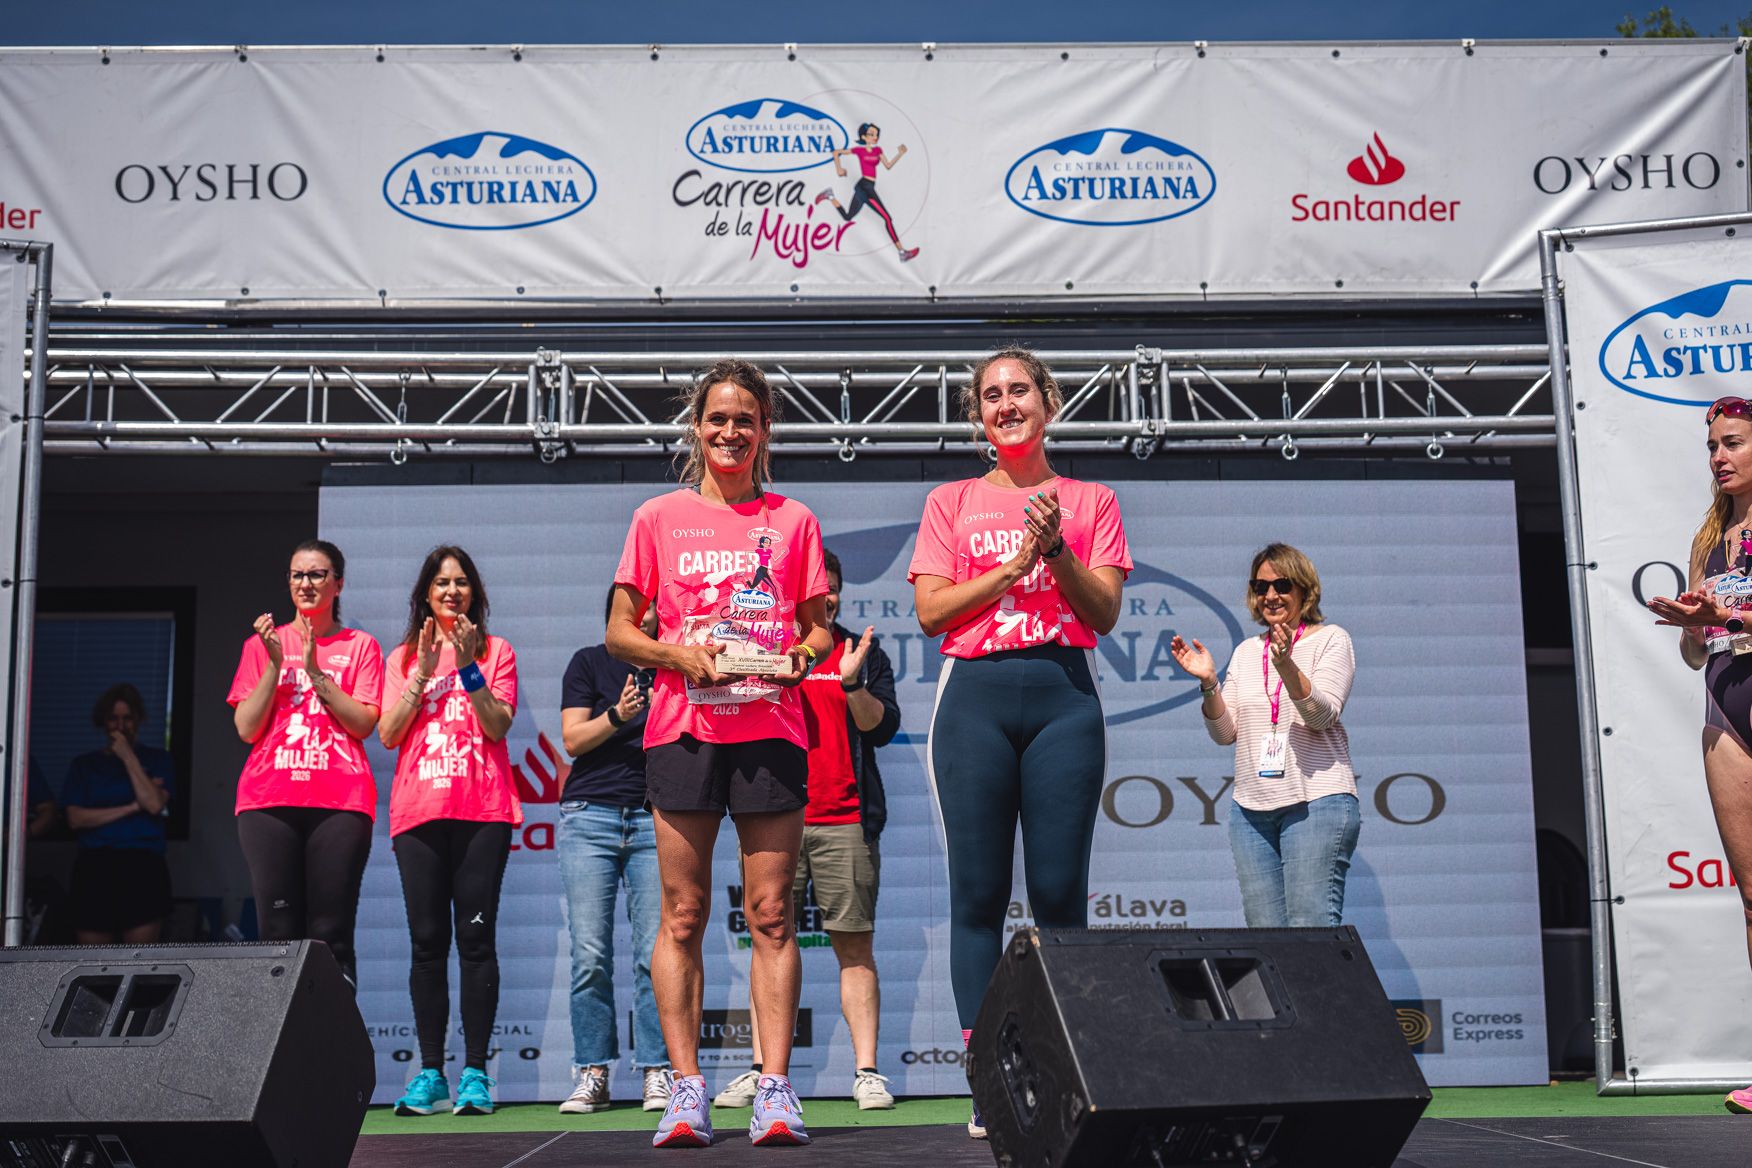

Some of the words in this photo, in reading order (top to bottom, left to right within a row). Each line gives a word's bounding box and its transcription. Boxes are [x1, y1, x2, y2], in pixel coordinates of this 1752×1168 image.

[699, 126, 836, 154] ASTURIANA
[723, 124, 774, 132] CENTRAL
[779, 123, 832, 132] LECHERA
[431, 166, 499, 176] CENTRAL
[505, 165, 574, 175] LECHERA
[1053, 162, 1120, 172] CENTRAL
[1127, 161, 1193, 171] LECHERA
[1533, 152, 1721, 194] OYSHO
[115, 162, 308, 203] OYSHO
[400, 168, 581, 205] ASTURIANA
[672, 169, 806, 208] Carrera
[1021, 165, 1201, 201] ASTURIANA
[1291, 193, 1461, 222] Santander
[705, 211, 730, 237] de
[736, 211, 753, 237] la
[750, 203, 856, 269] Mujer
[964, 511, 1004, 524] OYSHO
[672, 528, 715, 539] OYSHO
[970, 529, 1029, 558] CARR
[678, 550, 772, 577] CARRER
[720, 605, 768, 621] Carrera
[736, 595, 771, 606] ASTURIANA
[746, 620, 796, 651] Mujer
[444, 695, 467, 722] DE
[713, 703, 740, 715] 2026
[274, 747, 330, 770] MUJER
[418, 757, 468, 780] MUJER
[1095, 894, 1187, 918] álava
[1452, 1012, 1523, 1025] Correos
[1453, 1027, 1524, 1042] Express
